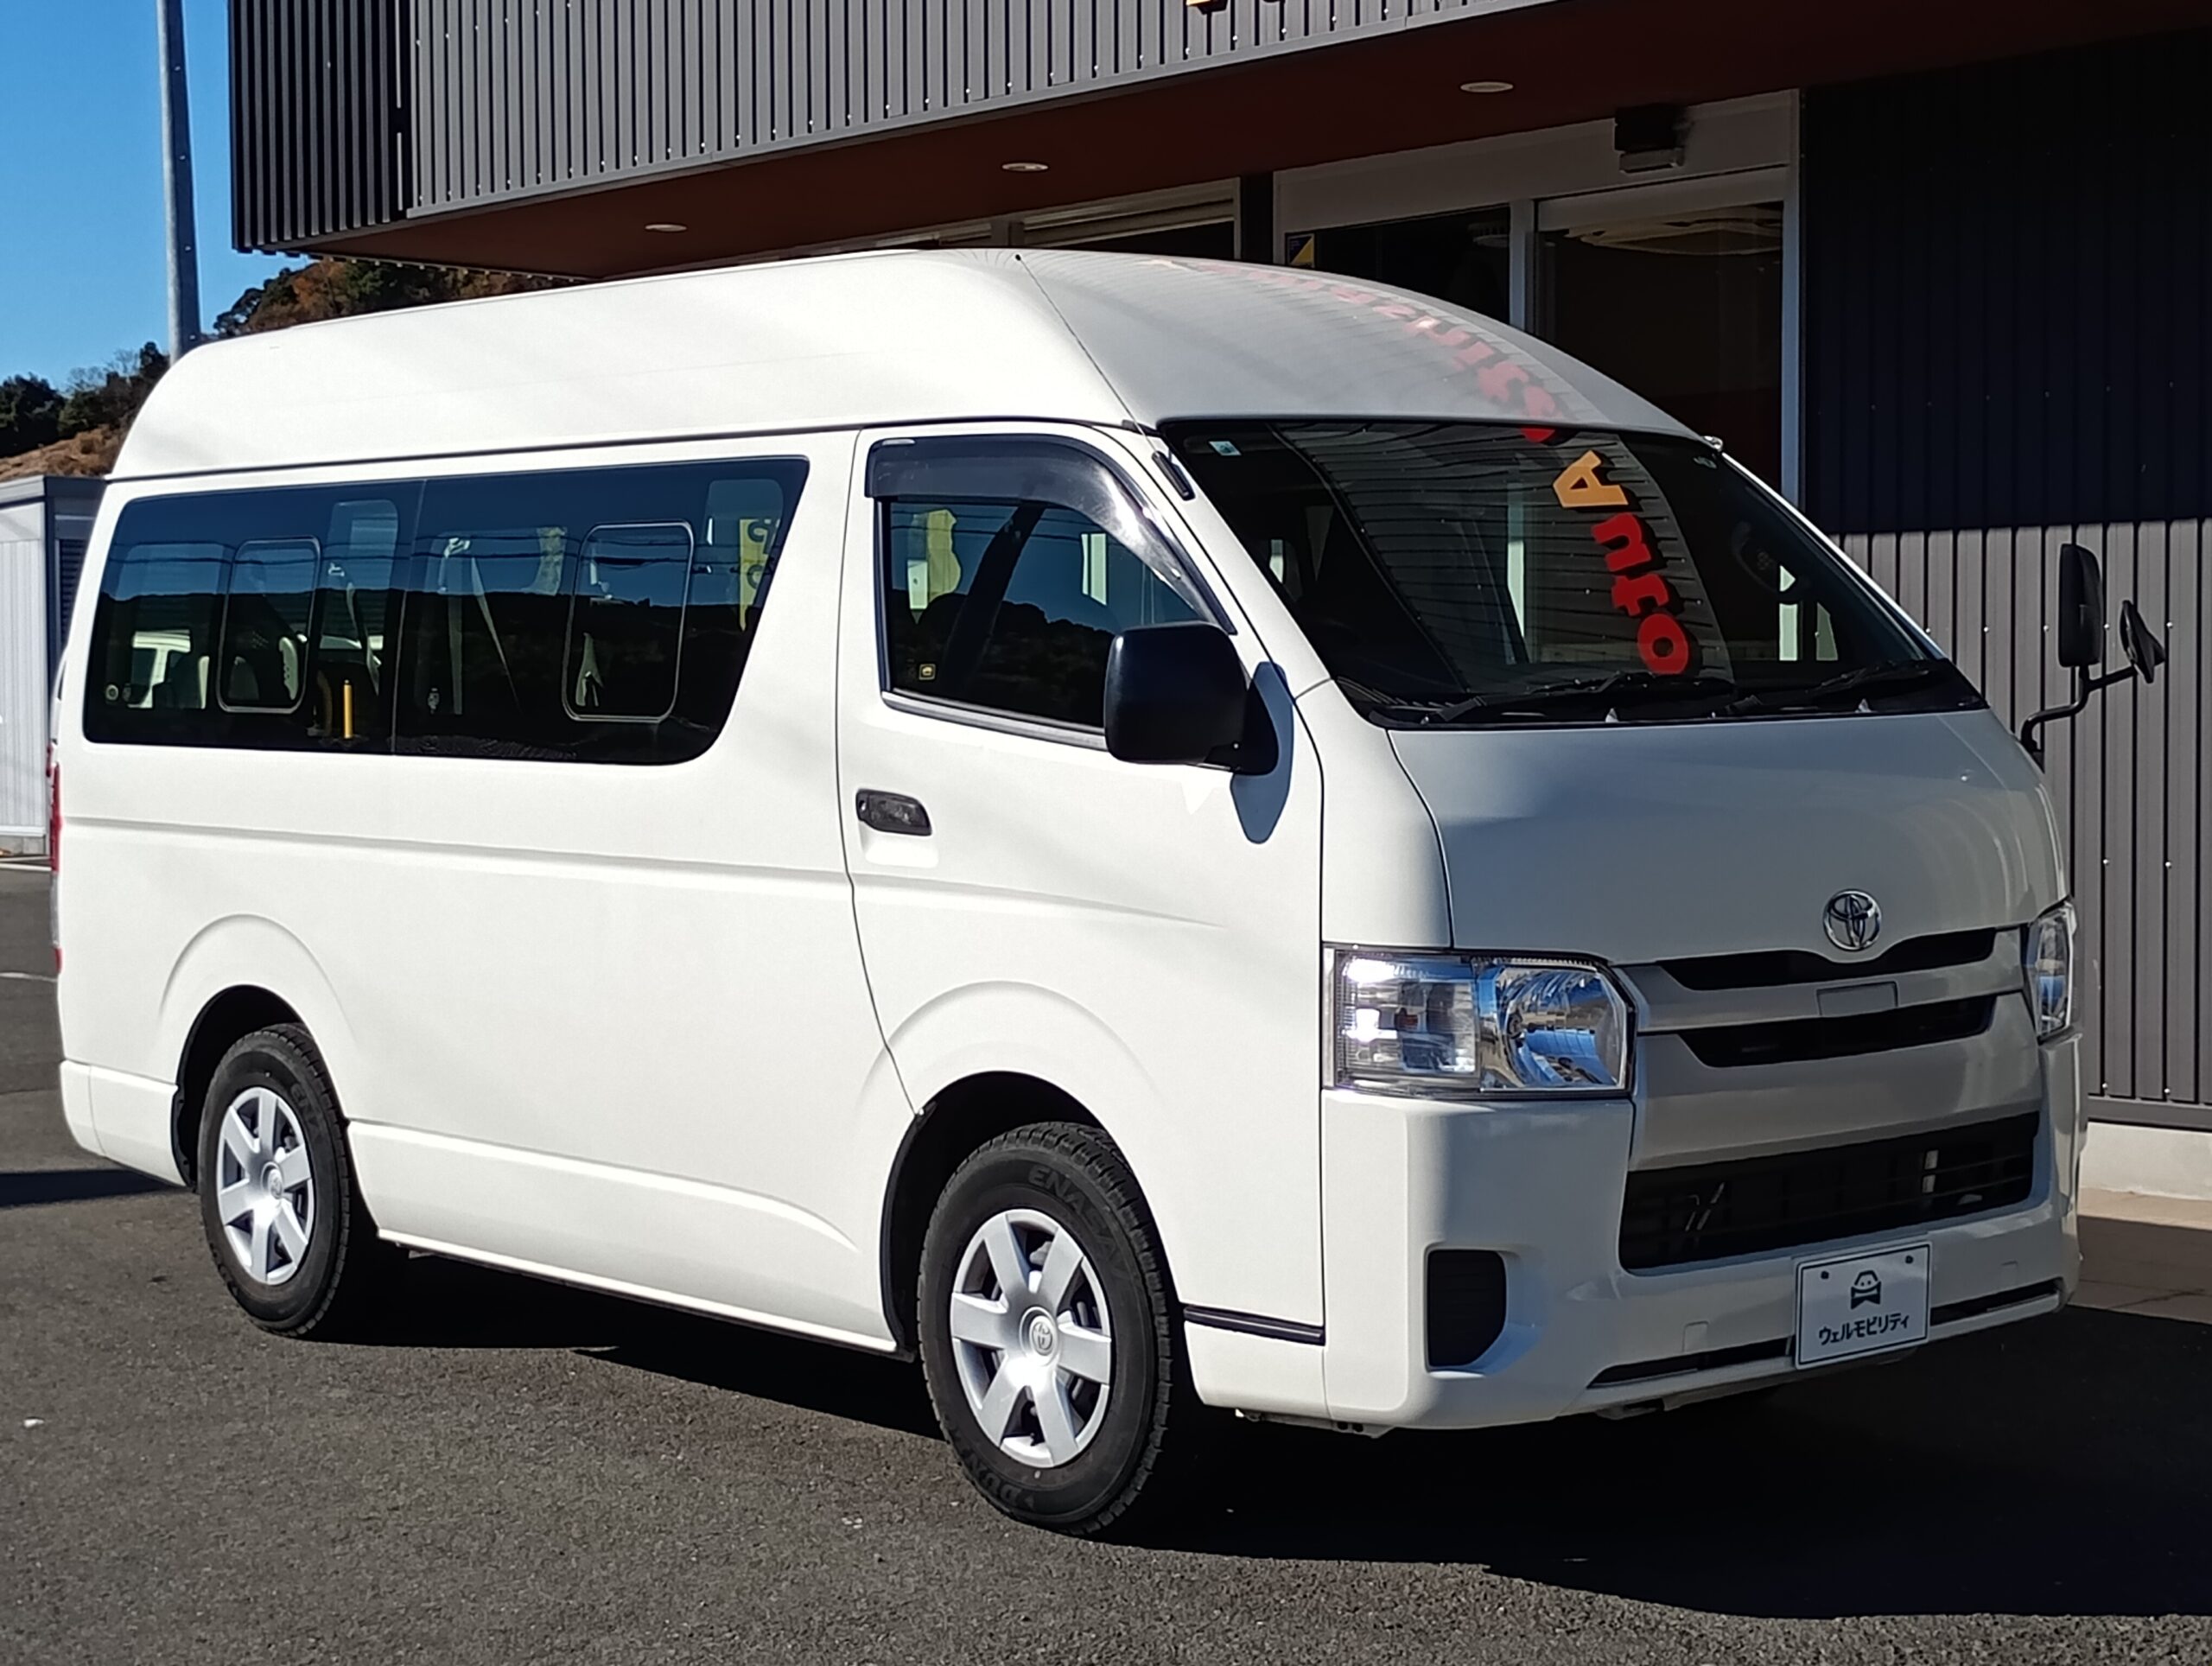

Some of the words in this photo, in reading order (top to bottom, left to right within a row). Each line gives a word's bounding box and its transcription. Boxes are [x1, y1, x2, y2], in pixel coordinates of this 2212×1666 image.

[1819, 1313, 1910, 1345] ウェルモビリティ
